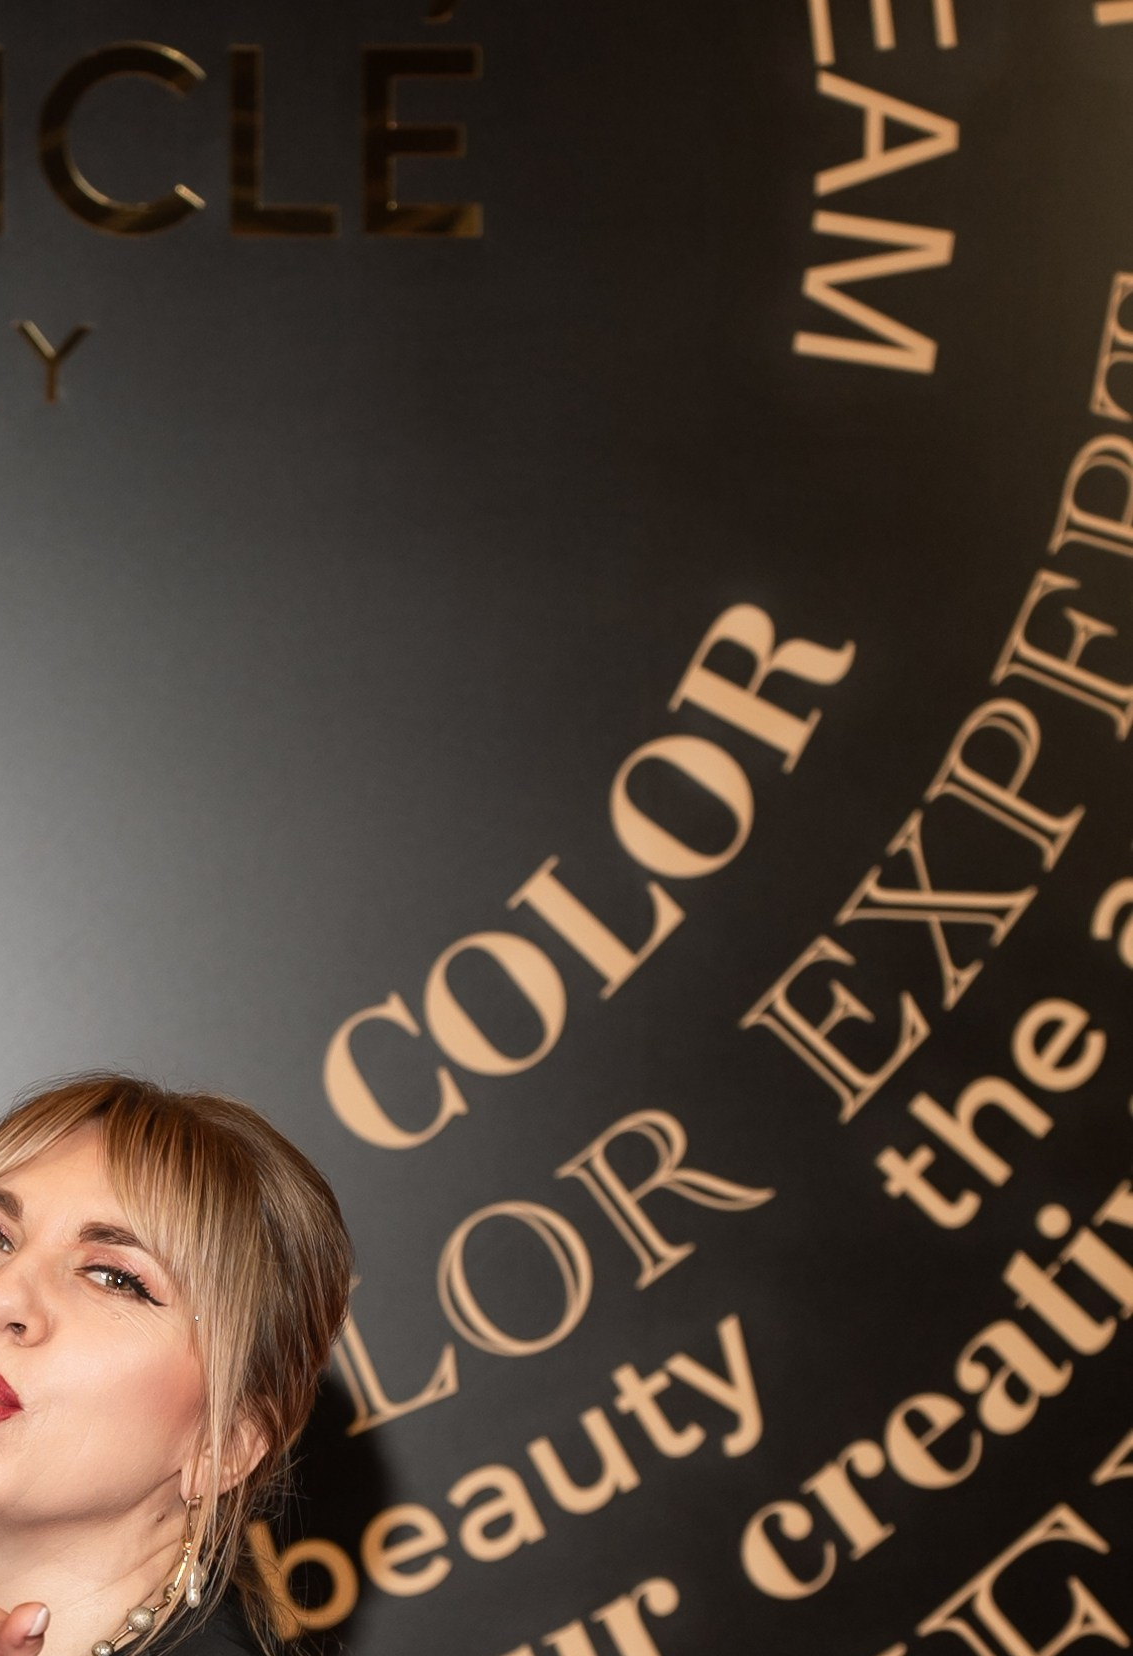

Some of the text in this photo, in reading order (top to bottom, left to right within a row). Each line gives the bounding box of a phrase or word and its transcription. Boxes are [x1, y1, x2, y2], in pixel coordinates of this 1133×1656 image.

[322, 602, 857, 1150] COLOR
[245, 996, 1107, 1642] beauty the
